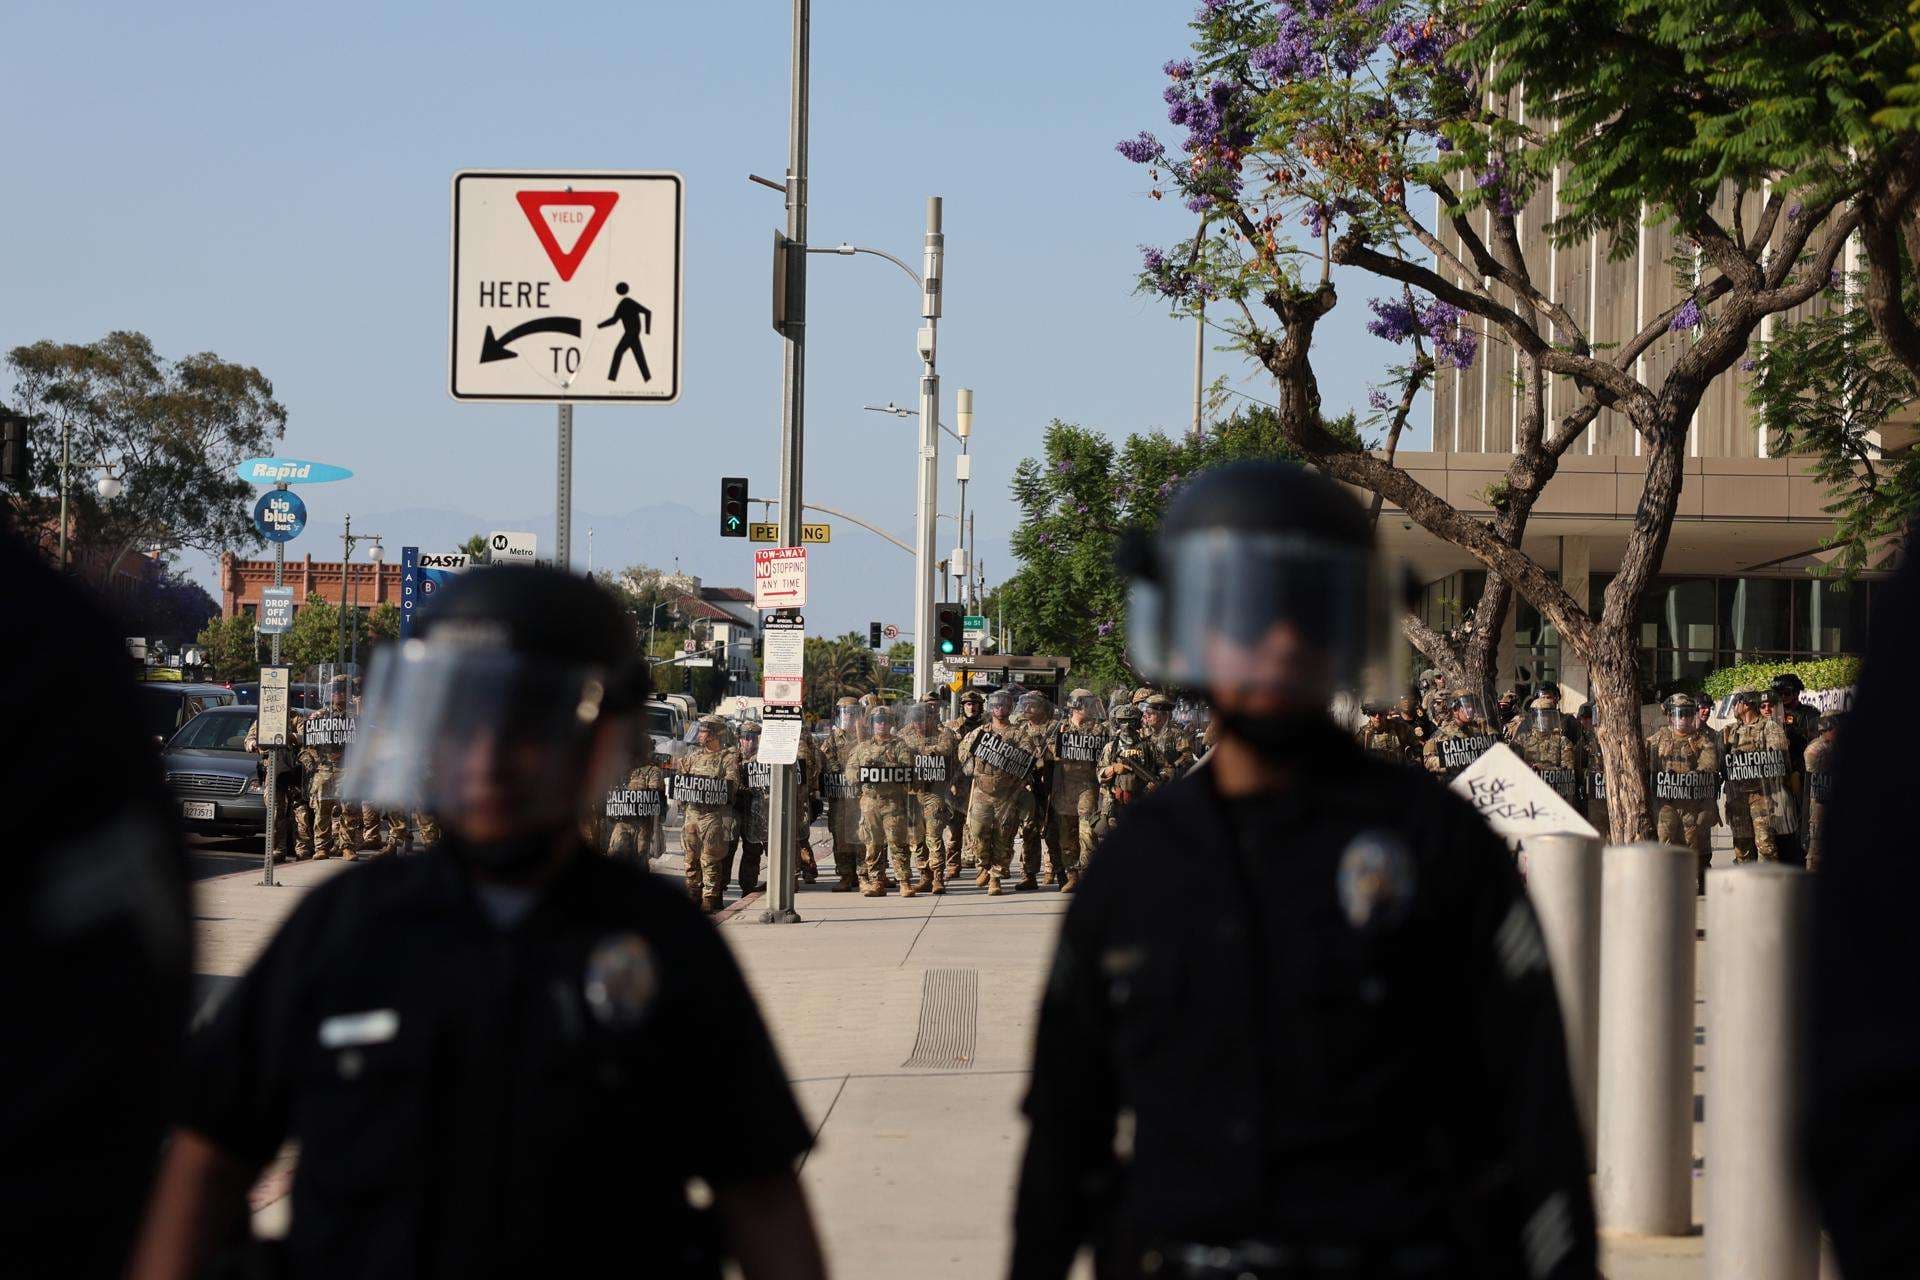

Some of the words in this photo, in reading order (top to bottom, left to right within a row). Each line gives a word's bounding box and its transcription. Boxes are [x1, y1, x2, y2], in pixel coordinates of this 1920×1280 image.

[552, 212, 583, 223] YIELD
[480, 281, 551, 308] HERE
[550, 347, 581, 373] TO
[252, 463, 310, 480] Rapid
[270, 499, 290, 512] big
[263, 508, 296, 523] blue
[274, 523, 292, 531] bus
[509, 547, 533, 556] Metro
[757, 548, 804, 558] TOW-AWAY
[419, 555, 465, 568] DASH
[756, 562, 770, 577] NO
[772, 561, 804, 574] STOPPING
[425, 583, 431, 592] B
[762, 580, 777, 589] ANY
[783, 579, 800, 588] TIME
[265, 600, 289, 608] DROP
[267, 608, 284, 616] OFF
[265, 616, 288, 625] ONLY
[306, 719, 356, 732] CALIFORNIA
[306, 732, 332, 745] NATIONAL
[333, 730, 357, 744] GUARD
[980, 733, 1033, 767] CALIFORNIA
[1062, 746, 1094, 761] NATIONAL
[974, 744, 1008, 773] NATIONAL
[1725, 751, 1784, 767] CALIFORNIA
[860, 768, 912, 782] POLICE
[923, 769, 946, 781] GUARD
[1727, 763, 1763, 780] NATIONAL
[1764, 763, 1786, 777] GUARD
[674, 774, 728, 793] CALIFORNIA
[1657, 772, 1715, 786] CALIFORNIA
[607, 790, 660, 803] CALIFORNIA
[673, 789, 703, 803] NATIONAL
[705, 793, 728, 805] GUARD
[1657, 785, 1692, 800] NATIONAL
[1693, 786, 1715, 799] GUARD
[606, 803, 636, 816] NATIONAL
[638, 803, 660, 816] GUARD
